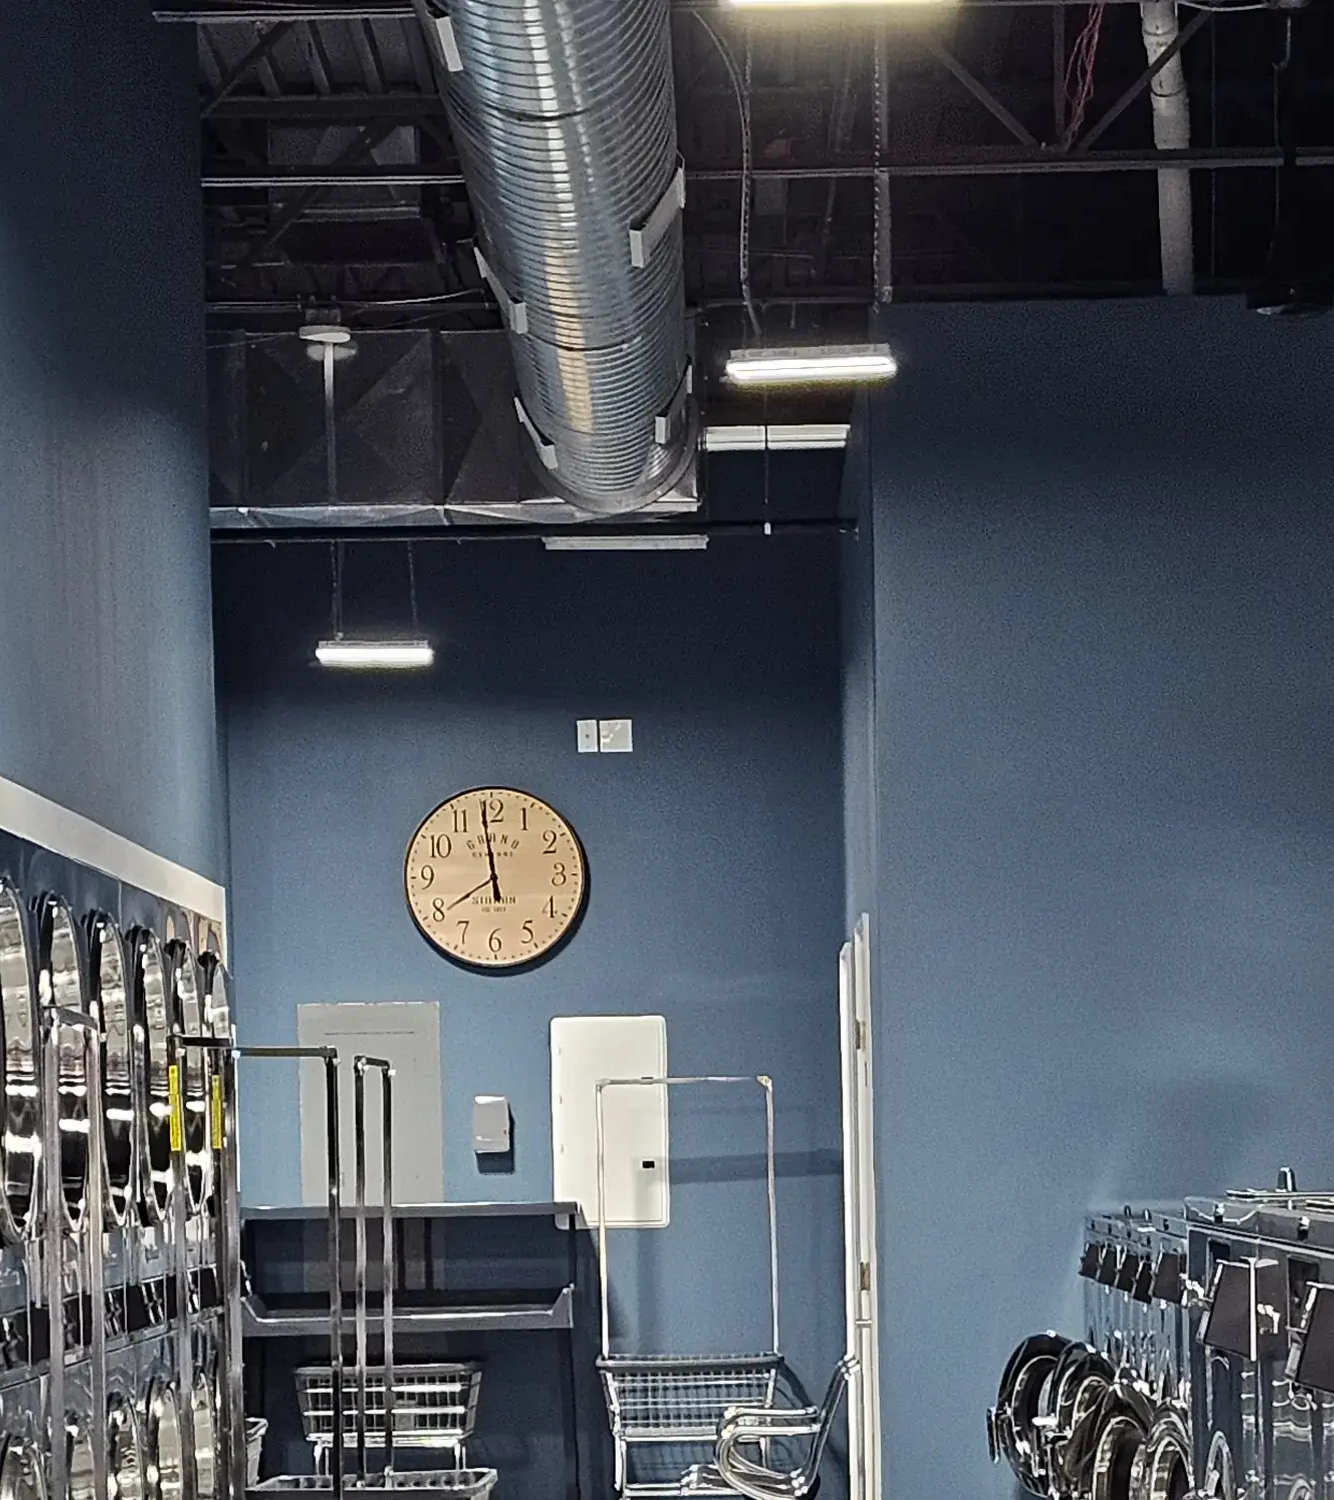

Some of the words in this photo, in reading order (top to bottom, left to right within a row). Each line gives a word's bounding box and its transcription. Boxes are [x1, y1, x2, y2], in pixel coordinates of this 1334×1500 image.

[453, 809, 468, 833] 11
[521, 807, 528, 831] 1
[430, 834, 452, 858] 10
[542, 830, 557, 854] 2
[421, 864, 435, 890] 9
[551, 862, 567, 887] 3
[432, 897, 446, 922] 8
[542, 895, 558, 918] 4
[456, 920, 470, 944] 7
[488, 928, 502, 952] 6
[521, 920, 534, 944] 5
